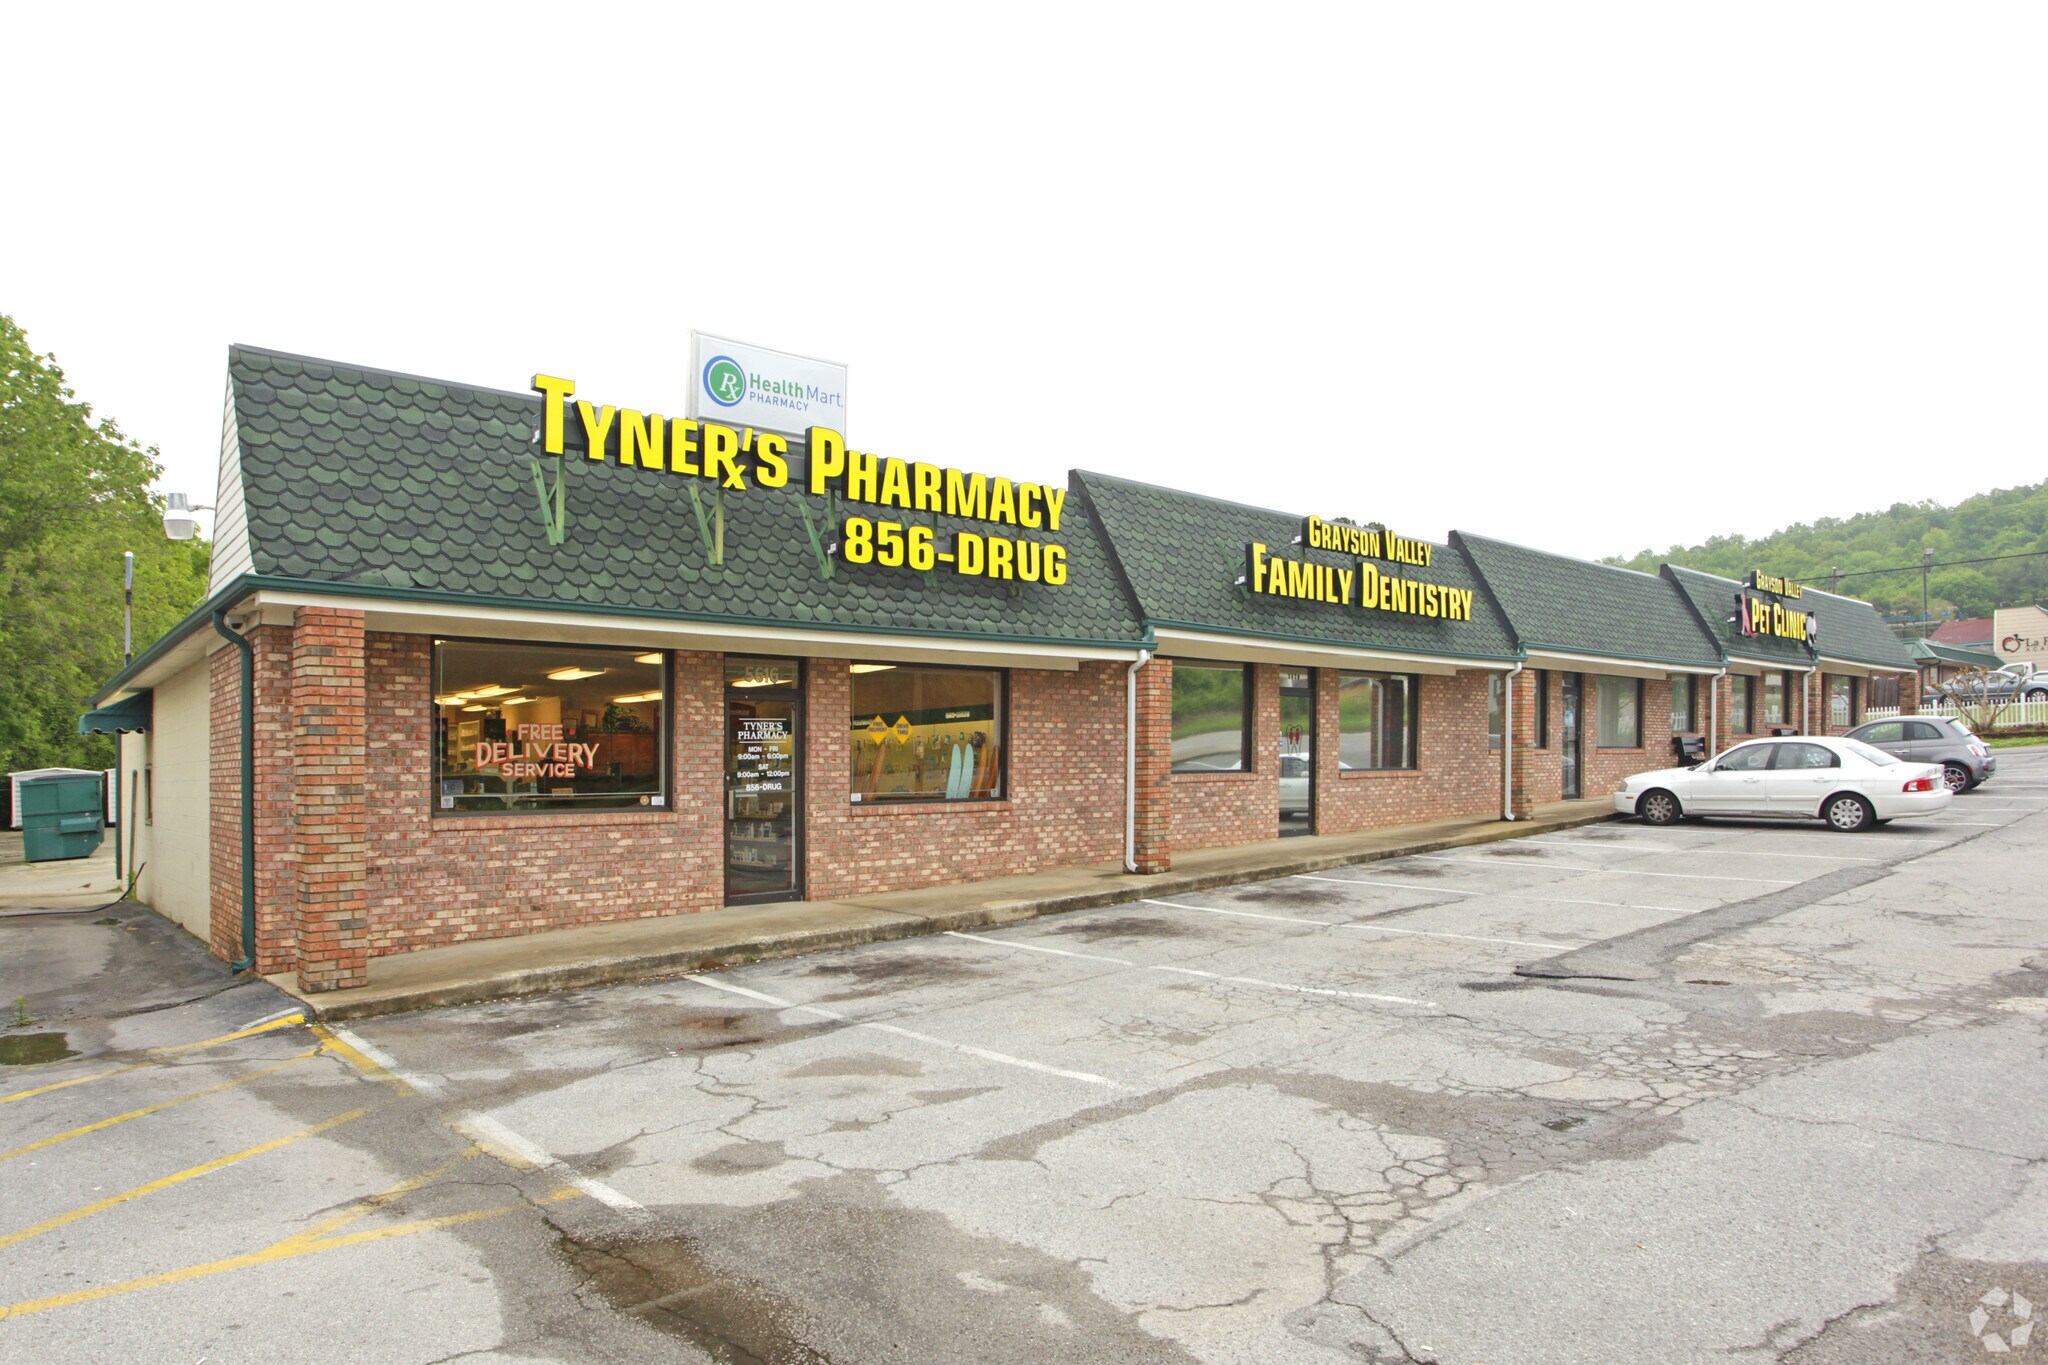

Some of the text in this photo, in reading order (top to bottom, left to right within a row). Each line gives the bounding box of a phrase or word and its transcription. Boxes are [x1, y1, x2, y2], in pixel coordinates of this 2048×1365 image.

[750, 373, 803, 399] Health
[750, 391, 809, 412] PHARMACY
[811, 426, 1067, 531] PHARMACY
[844, 516, 1067, 585] 856-DRUG
[1308, 515, 1432, 567] GRAYSON VALLEY
[1252, 542, 1473, 621] FAMILY DENTISTRY
[1756, 569, 1783, 595] GRAYSON
[1751, 598, 1807, 641] PET CLINIC
[2026, 637, 2039, 647] La
[745, 666, 779, 683] 5616
[517, 723, 564, 741] FREE
[737, 731, 788, 740] PHARMACY
[743, 721, 783, 731] TYNER'S
[475, 742, 600, 771] DELIVERY
[502, 763, 576, 778] SERVICE
[745, 783, 782, 792] 856-DRUG
